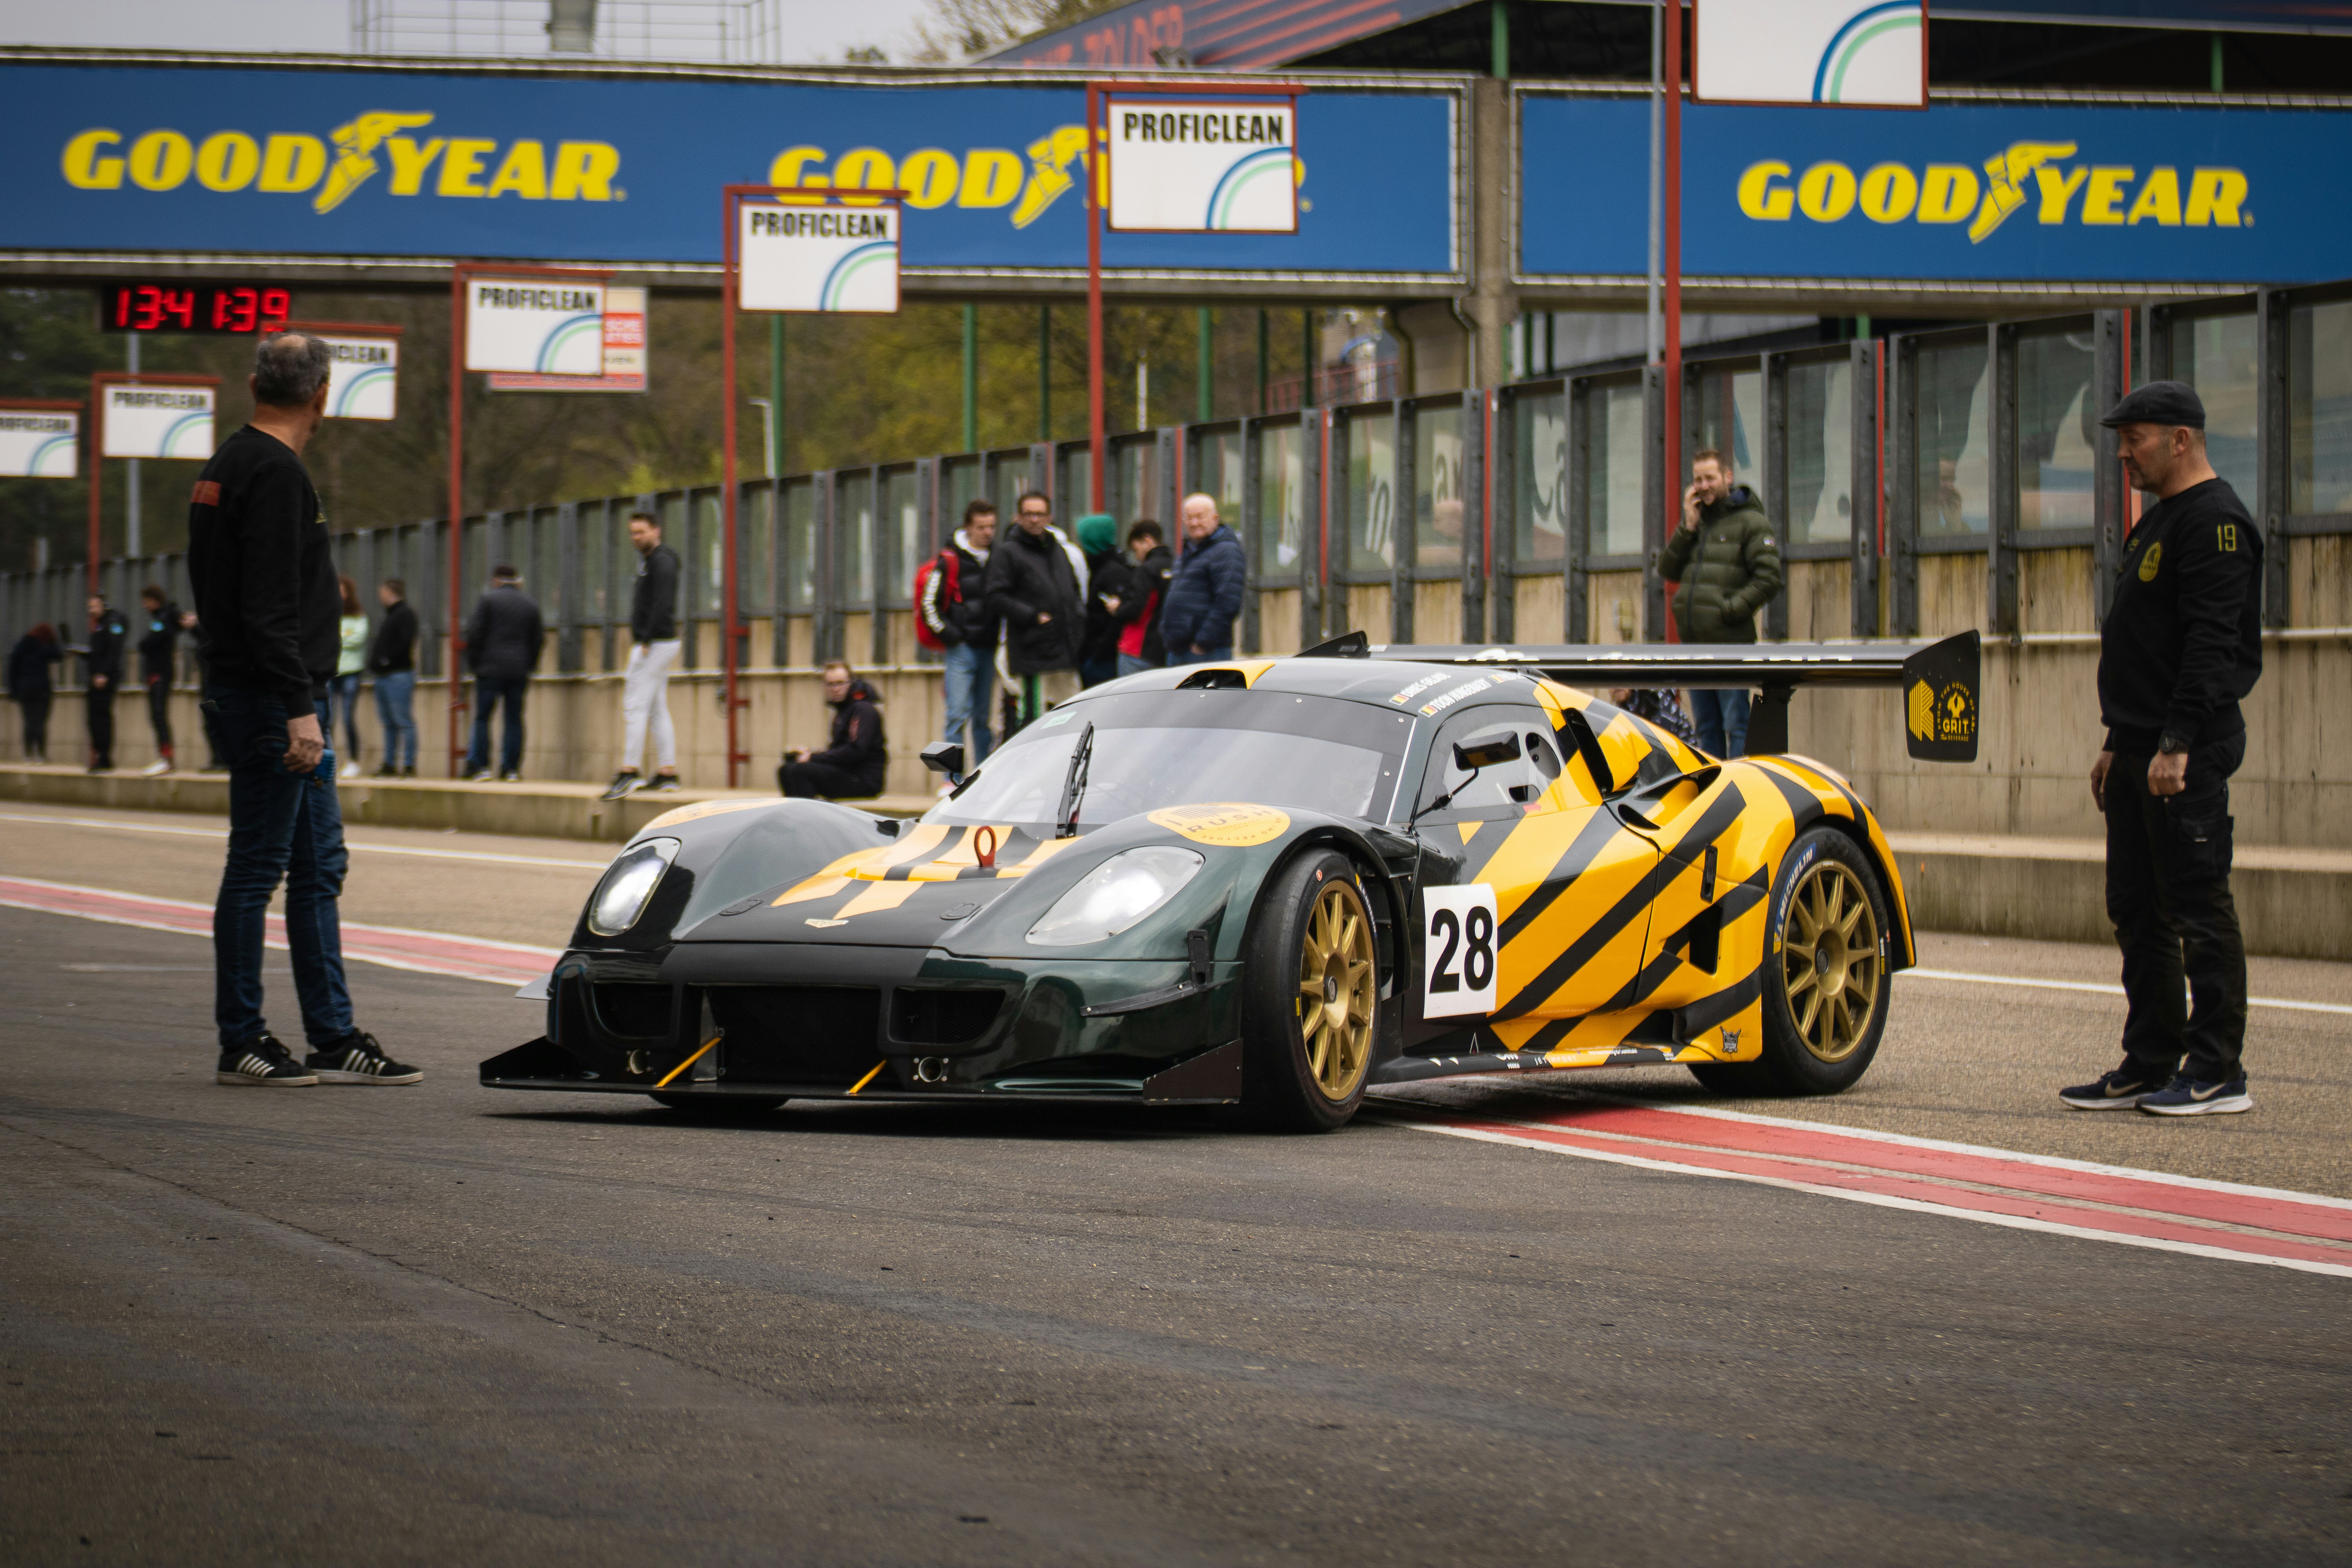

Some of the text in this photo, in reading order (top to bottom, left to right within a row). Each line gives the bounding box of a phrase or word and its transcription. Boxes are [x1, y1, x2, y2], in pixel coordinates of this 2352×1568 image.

[1123, 112, 1283, 145] PROFICLEAN
[62, 128, 620, 201] GOODYEAR
[1737, 160, 2249, 227] GOODYEAR
[751, 212, 887, 240] PROFICLEAN
[479, 287, 596, 310] PROFICLEAN
[114, 392, 207, 409] PROFICLEAN
[2217, 523, 2237, 552] 19
[1941, 683, 1951, 699] THE
[1952, 680, 1970, 697] HOUSE
[1187, 810, 1273, 833] RUSH
[1780, 847, 1813, 921] MICHELIN
[1429, 906, 1494, 994] 28
